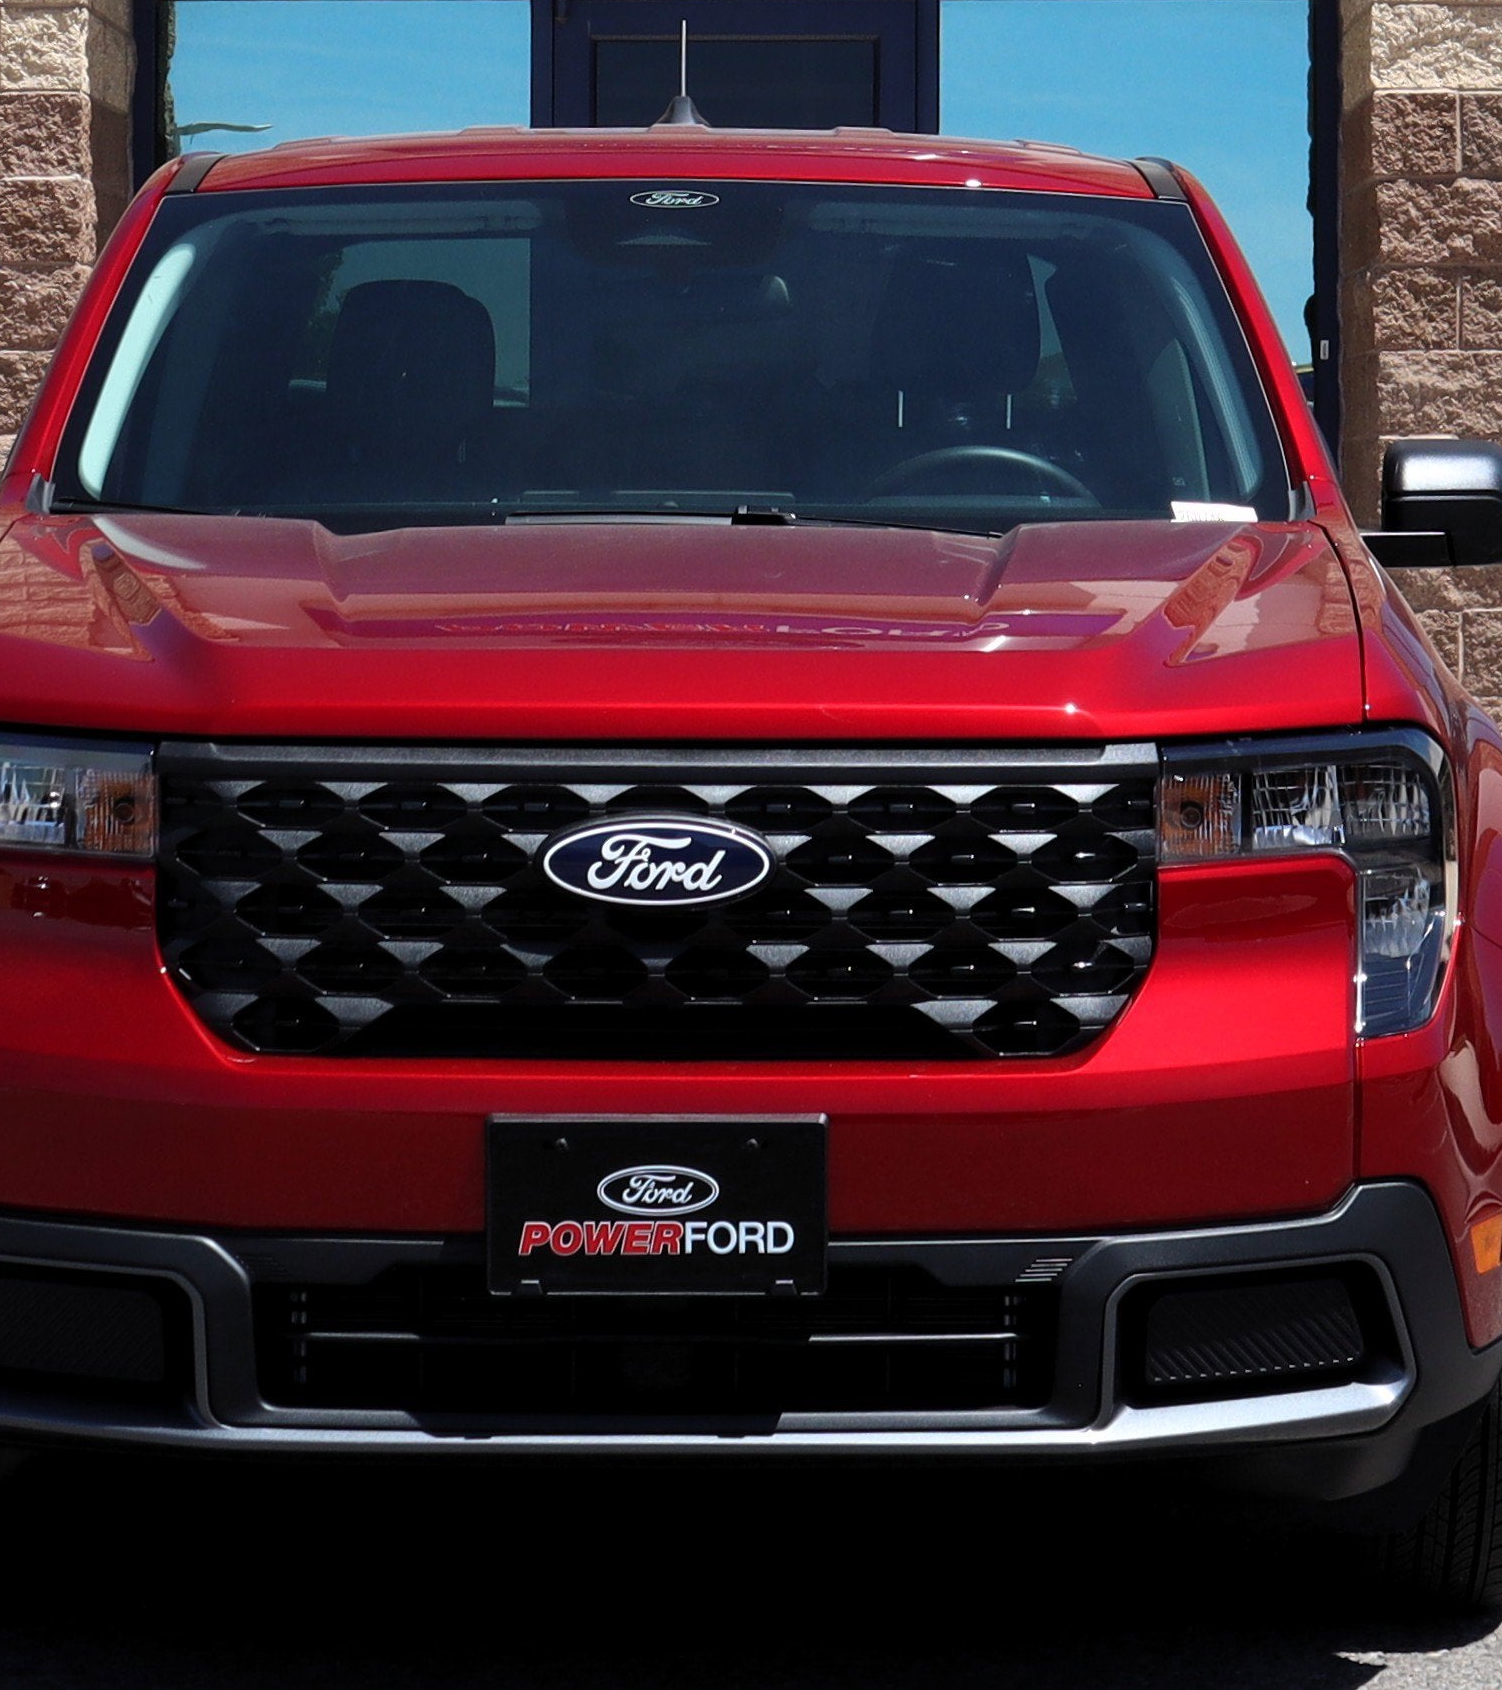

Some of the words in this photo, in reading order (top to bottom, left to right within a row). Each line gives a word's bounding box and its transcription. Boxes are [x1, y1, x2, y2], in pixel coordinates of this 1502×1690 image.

[645, 192, 704, 206] Ford
[587, 833, 726, 891] Ford
[622, 1174, 692, 1204] Ford
